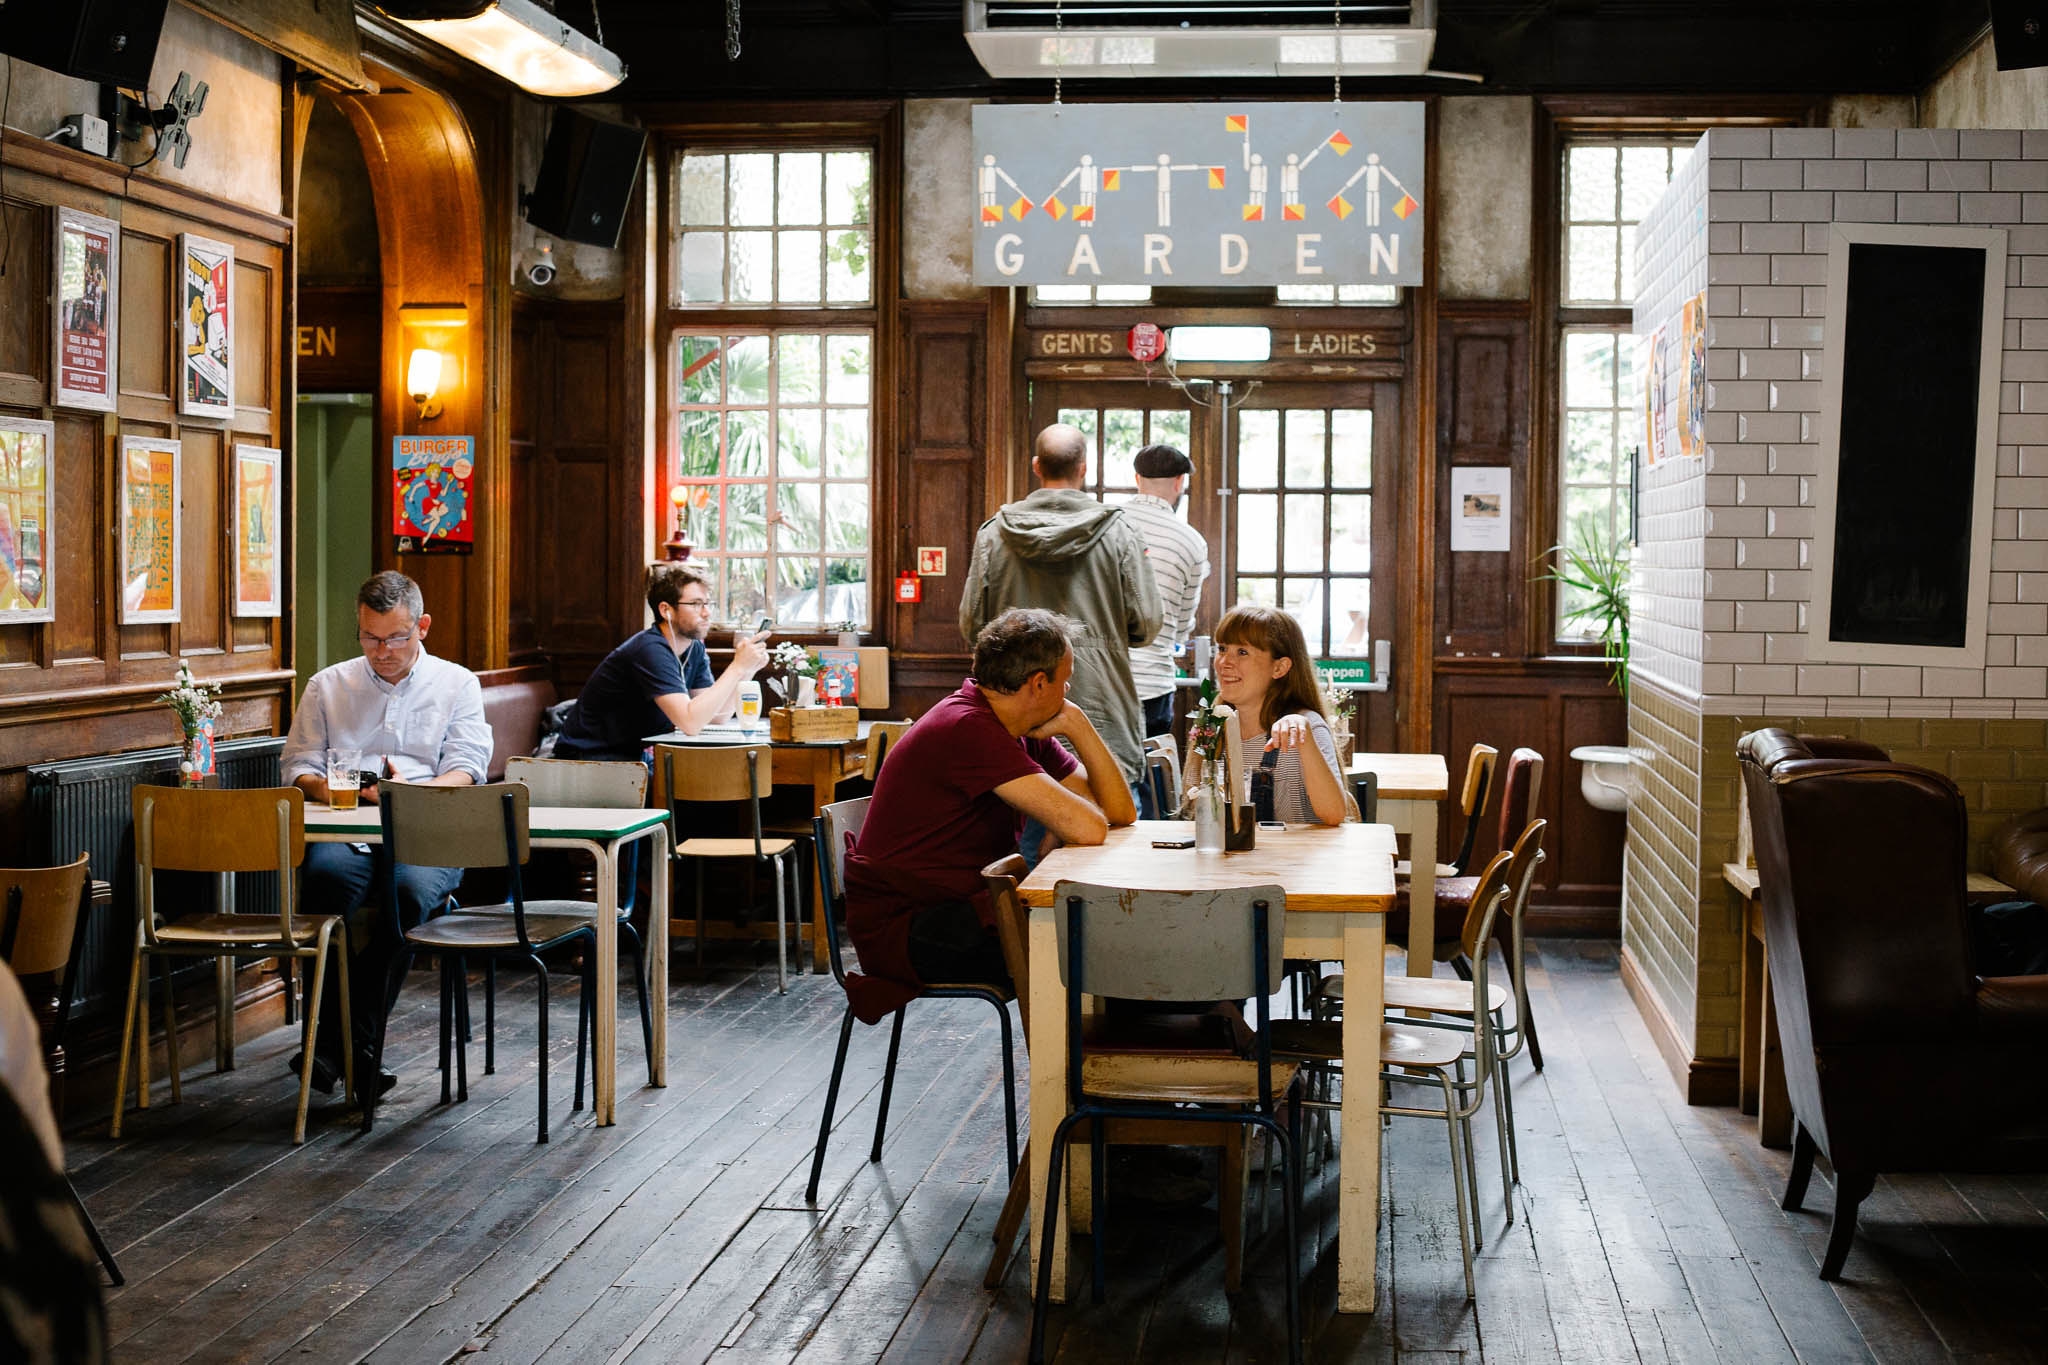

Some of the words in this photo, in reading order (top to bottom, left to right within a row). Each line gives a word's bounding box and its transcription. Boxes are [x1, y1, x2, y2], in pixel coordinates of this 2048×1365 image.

[994, 232, 1400, 276] GARDEN
[1042, 333, 1113, 354] GENTS
[1294, 333, 1377, 355] LADIES
[400, 439, 468, 455] BURGER
[1333, 668, 1364, 680] open
